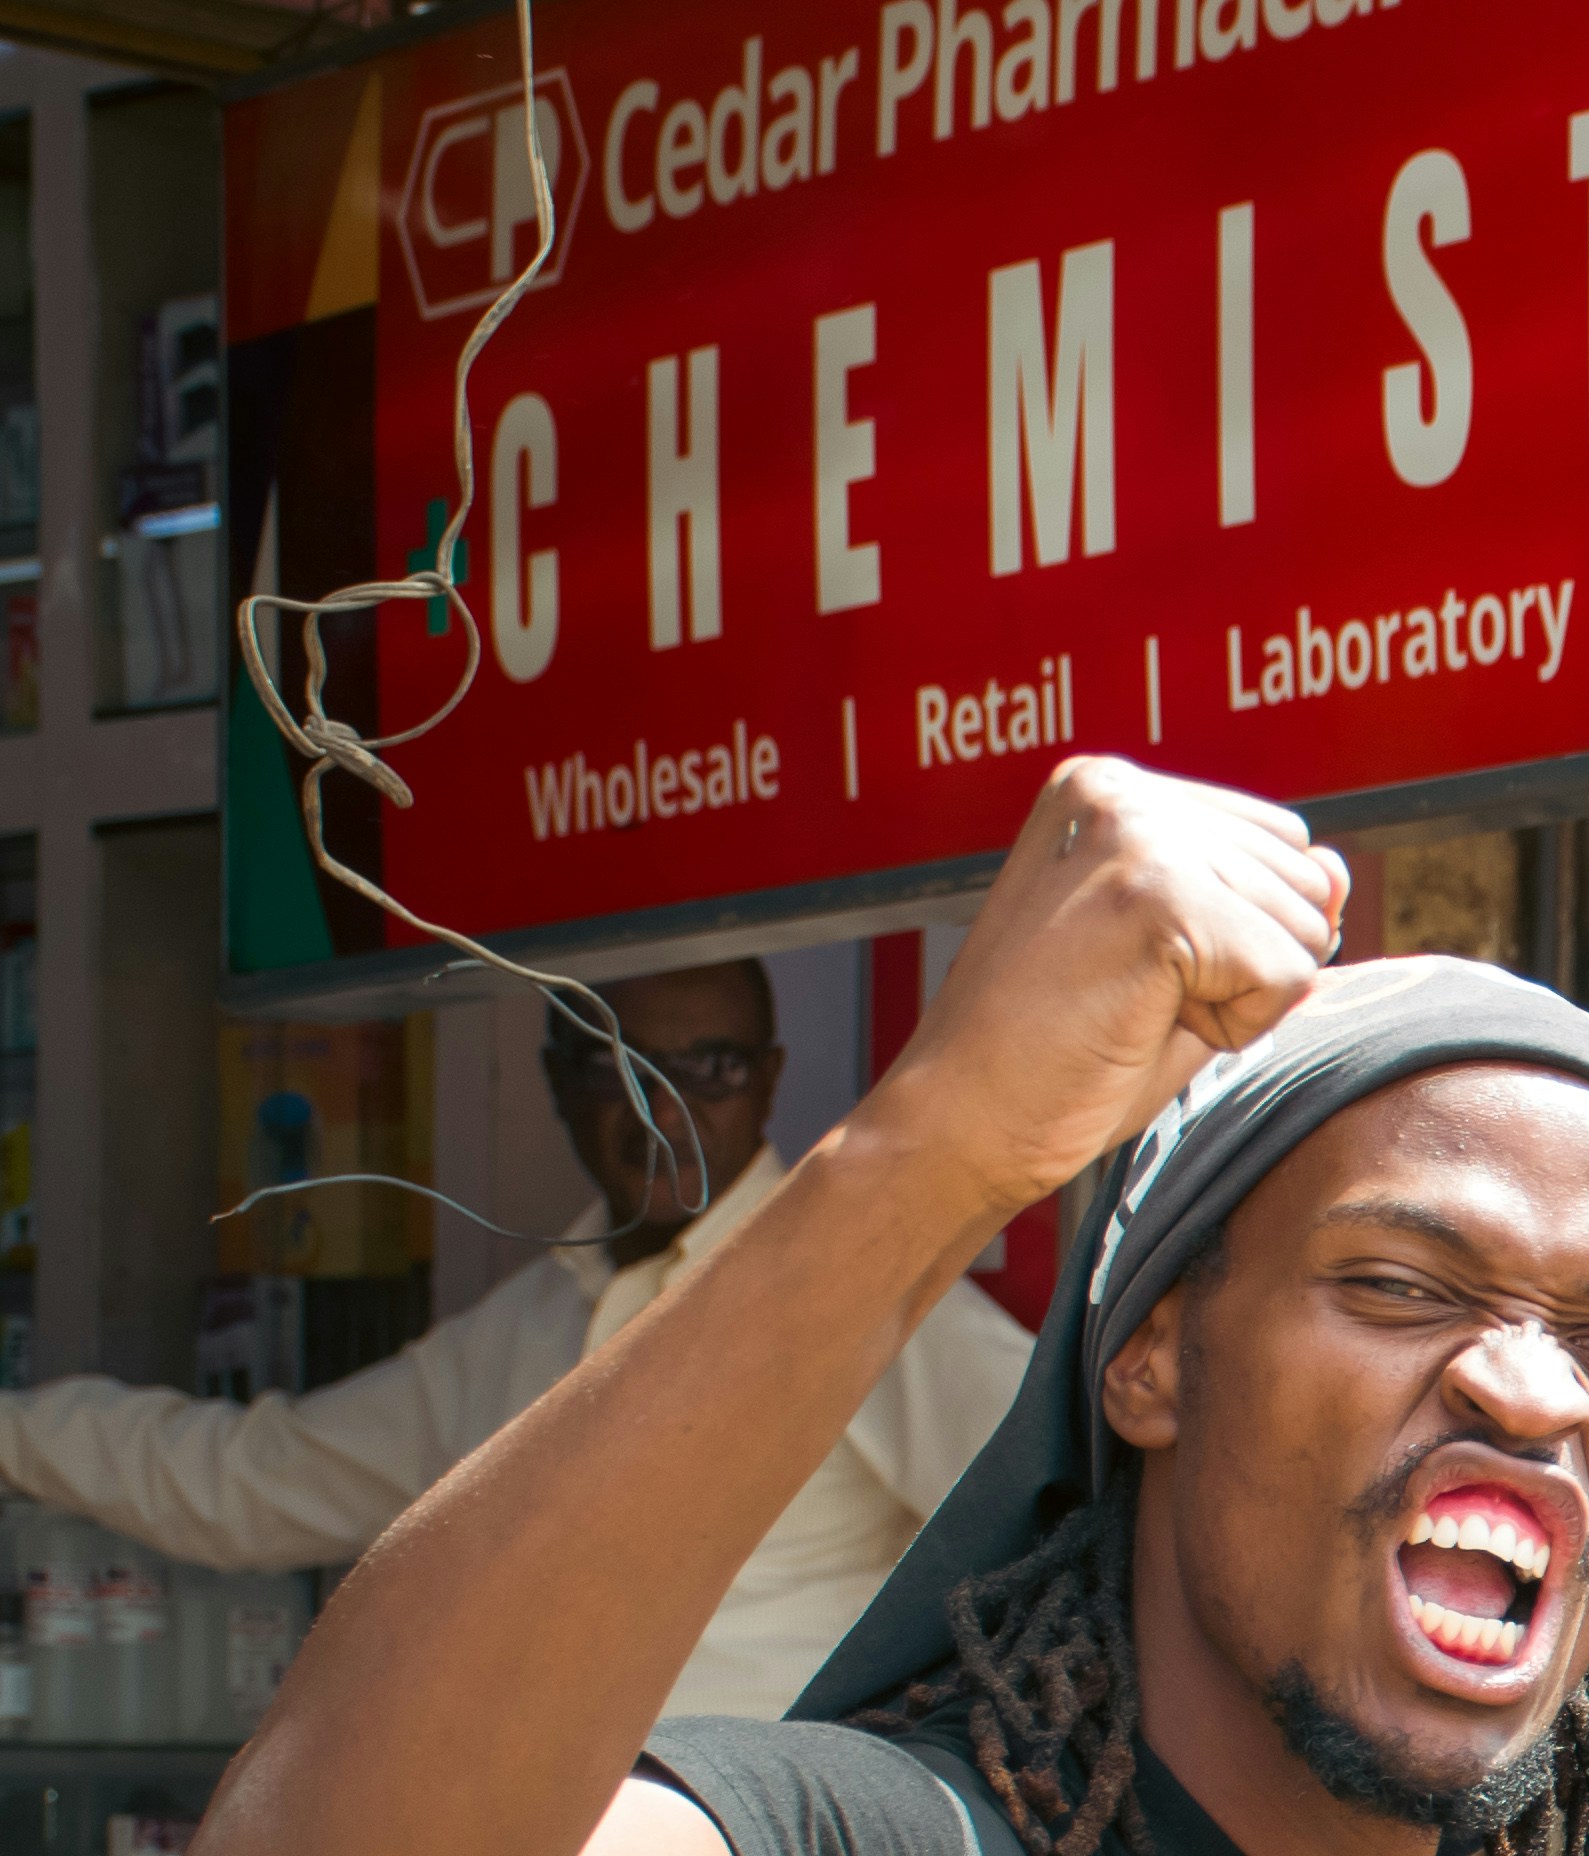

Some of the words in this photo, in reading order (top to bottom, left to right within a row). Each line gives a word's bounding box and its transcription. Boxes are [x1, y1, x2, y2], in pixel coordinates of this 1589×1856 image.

[603, 37, 861, 234] Cedar
[876, 0, 1402, 155] Pharma
[525, 719, 782, 841] Wholesale
[916, 656, 1074, 768] Retail
[1227, 578, 1576, 711] Laboratory
